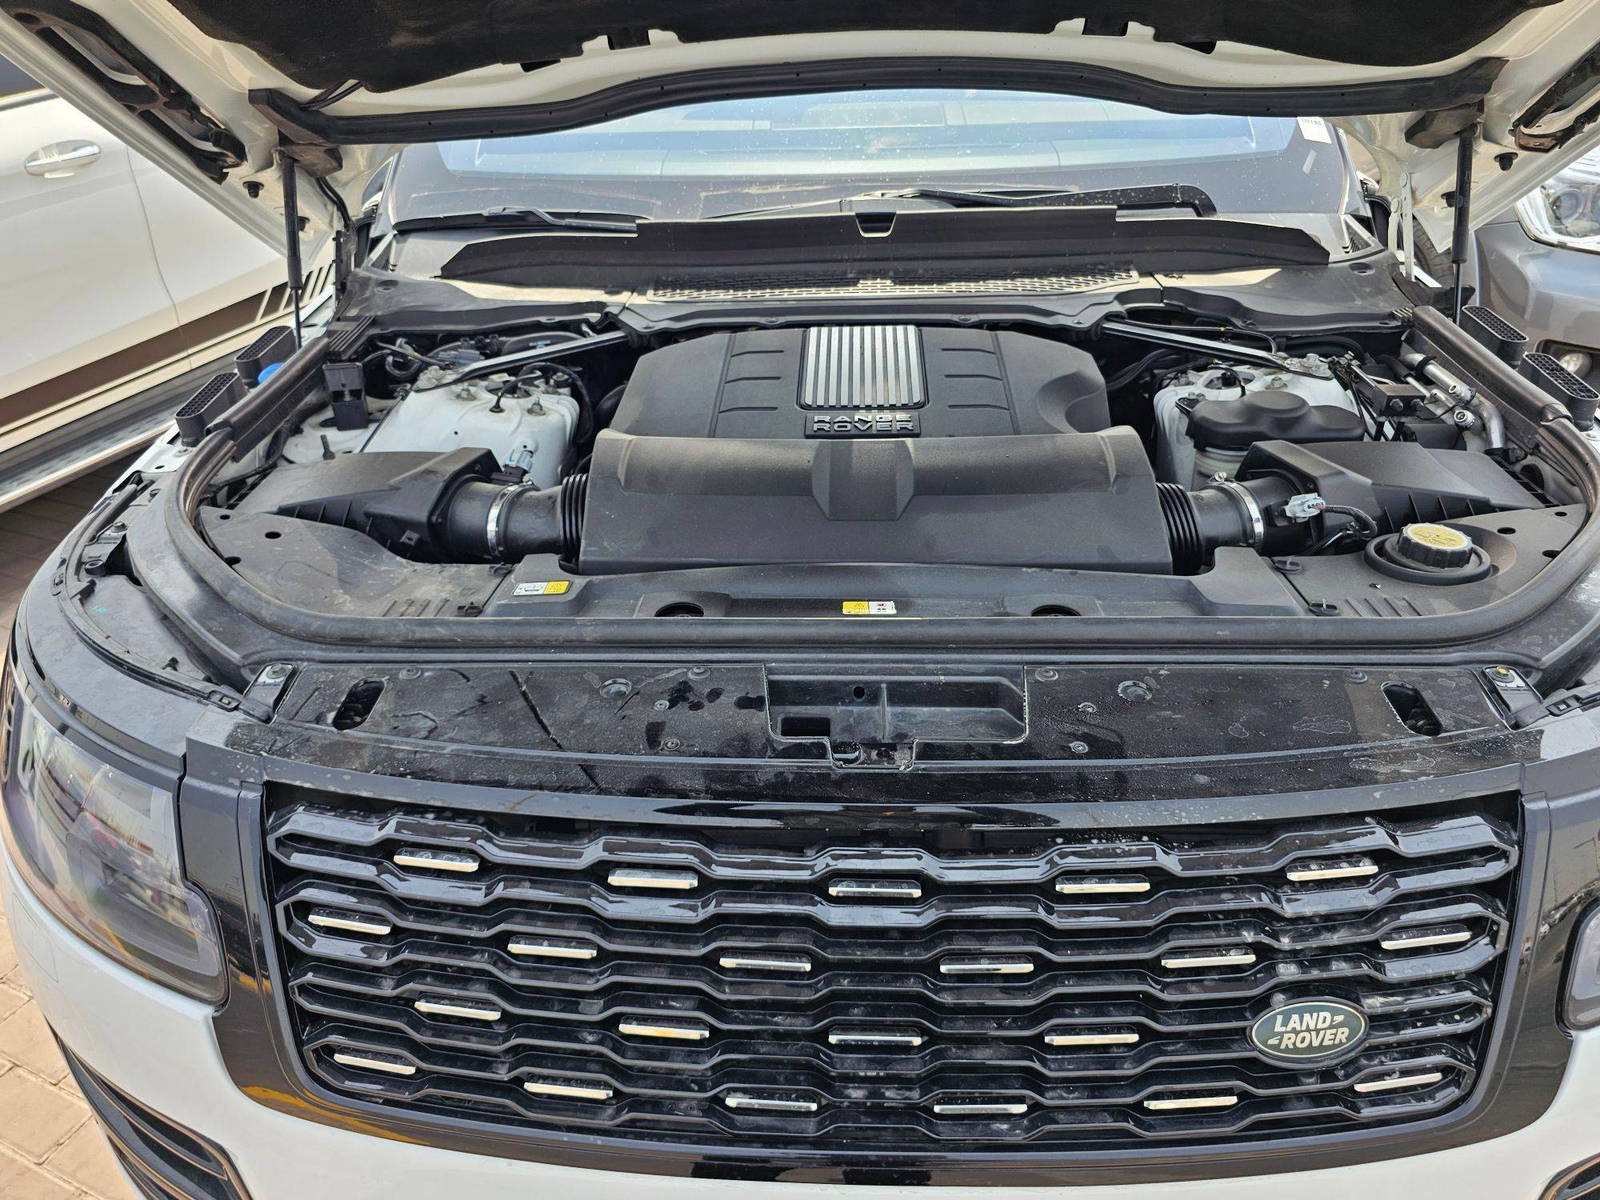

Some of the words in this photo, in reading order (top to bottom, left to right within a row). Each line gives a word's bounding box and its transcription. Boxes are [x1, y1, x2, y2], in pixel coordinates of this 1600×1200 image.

[813, 414, 913, 422] RANGE
[813, 421, 914, 432] ROVER
[1274, 1011, 1332, 1032] LAND
[1280, 1027, 1350, 1050] ROVER
